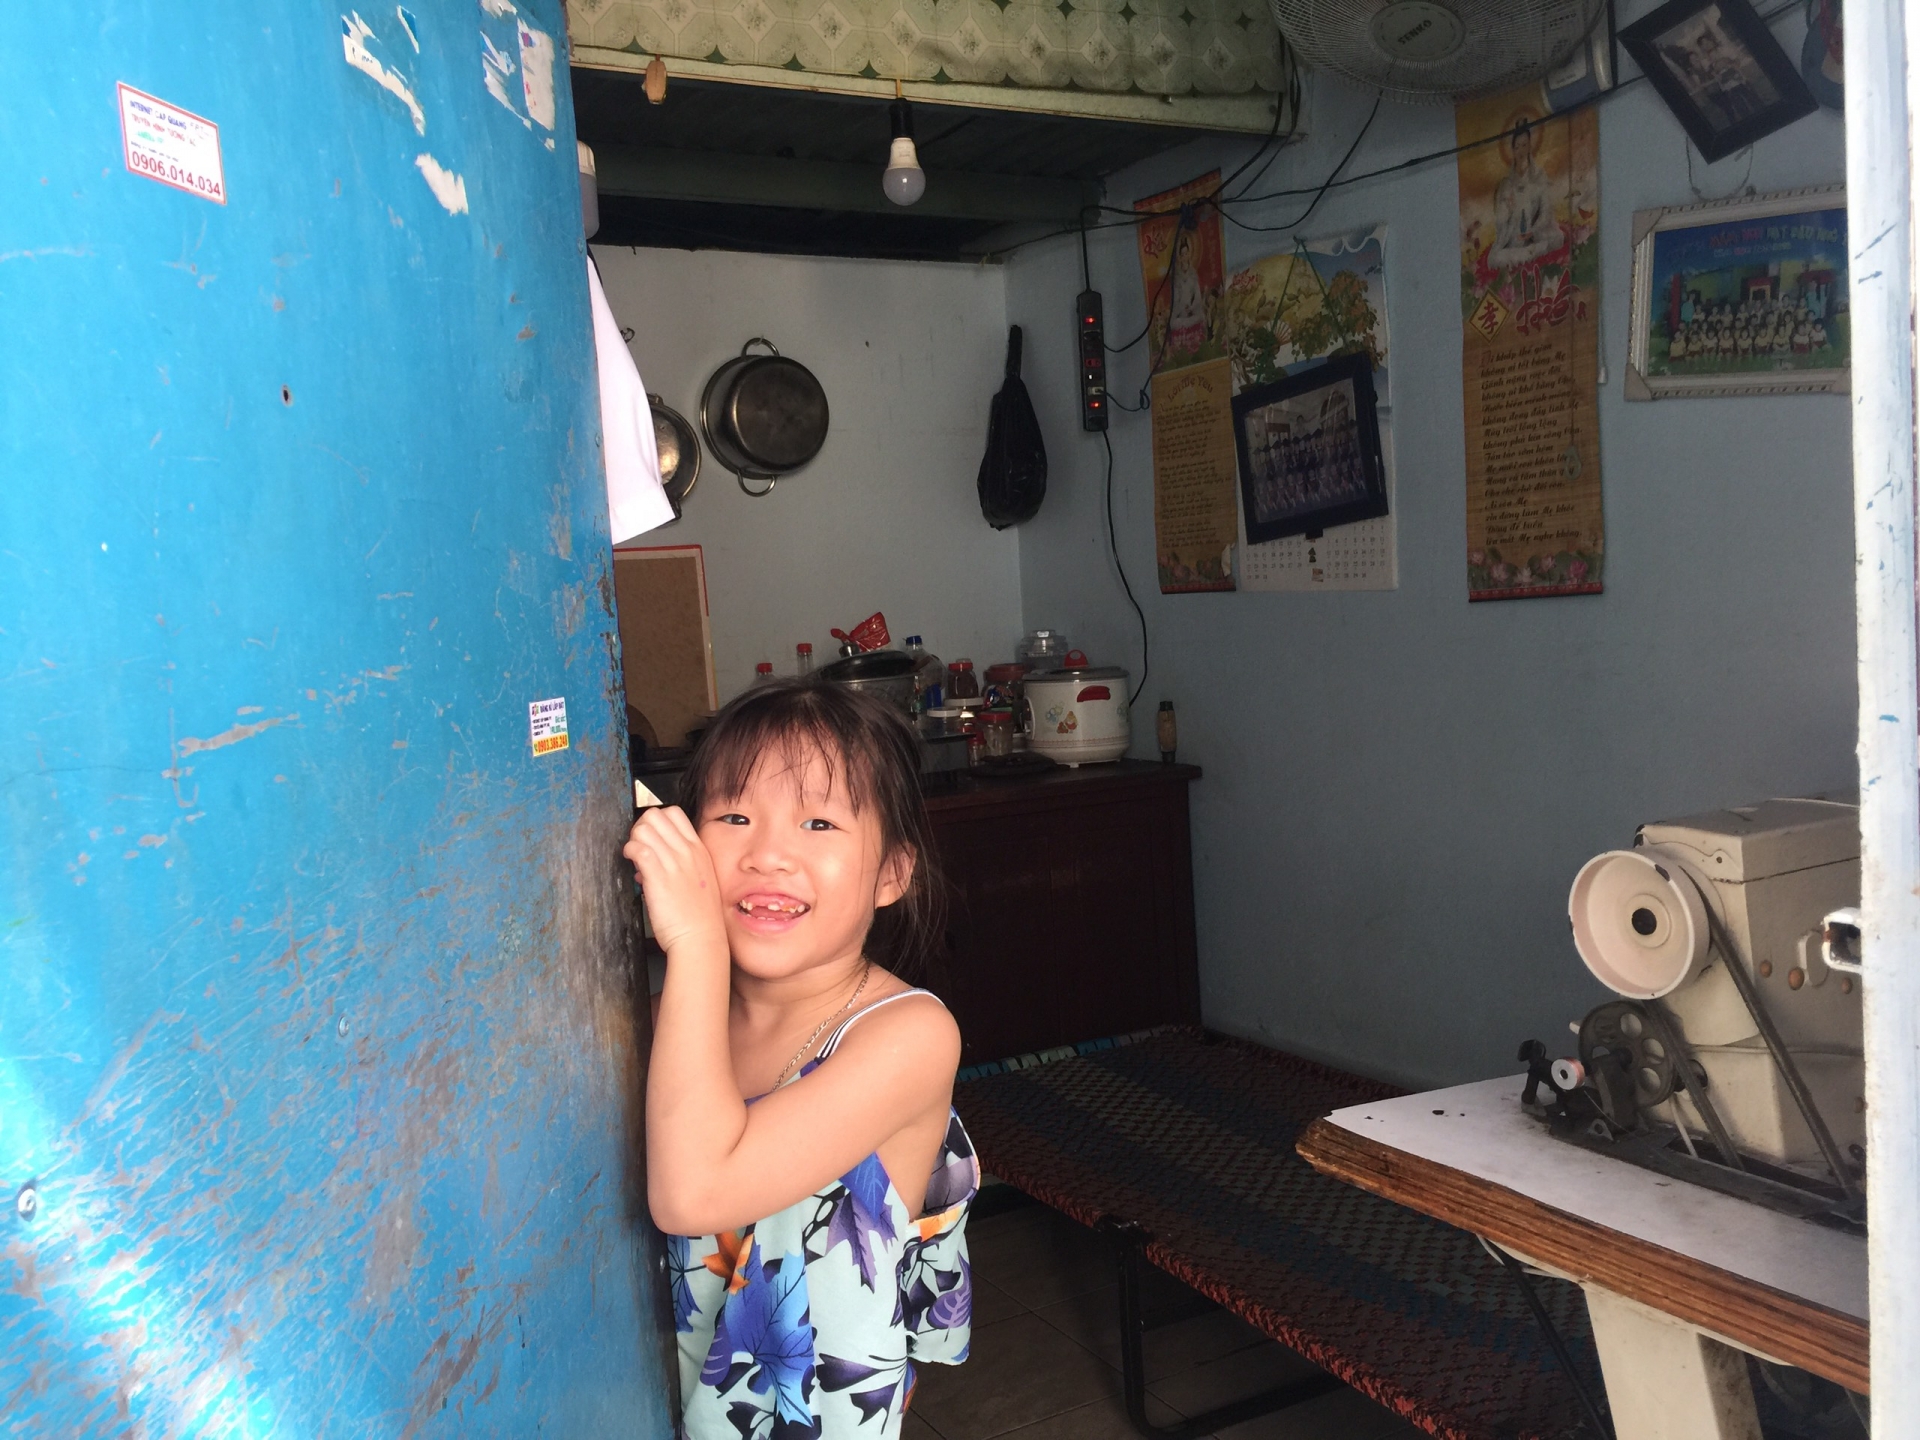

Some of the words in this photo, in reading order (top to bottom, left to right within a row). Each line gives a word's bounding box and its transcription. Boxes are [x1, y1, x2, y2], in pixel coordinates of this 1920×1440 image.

[1397, 19, 1432, 45] SENKO
[132, 151, 221, 197] 0906.014.034
[1478, 300, 1500, 335] 孝
[1559, 467, 1575, 476] gy
